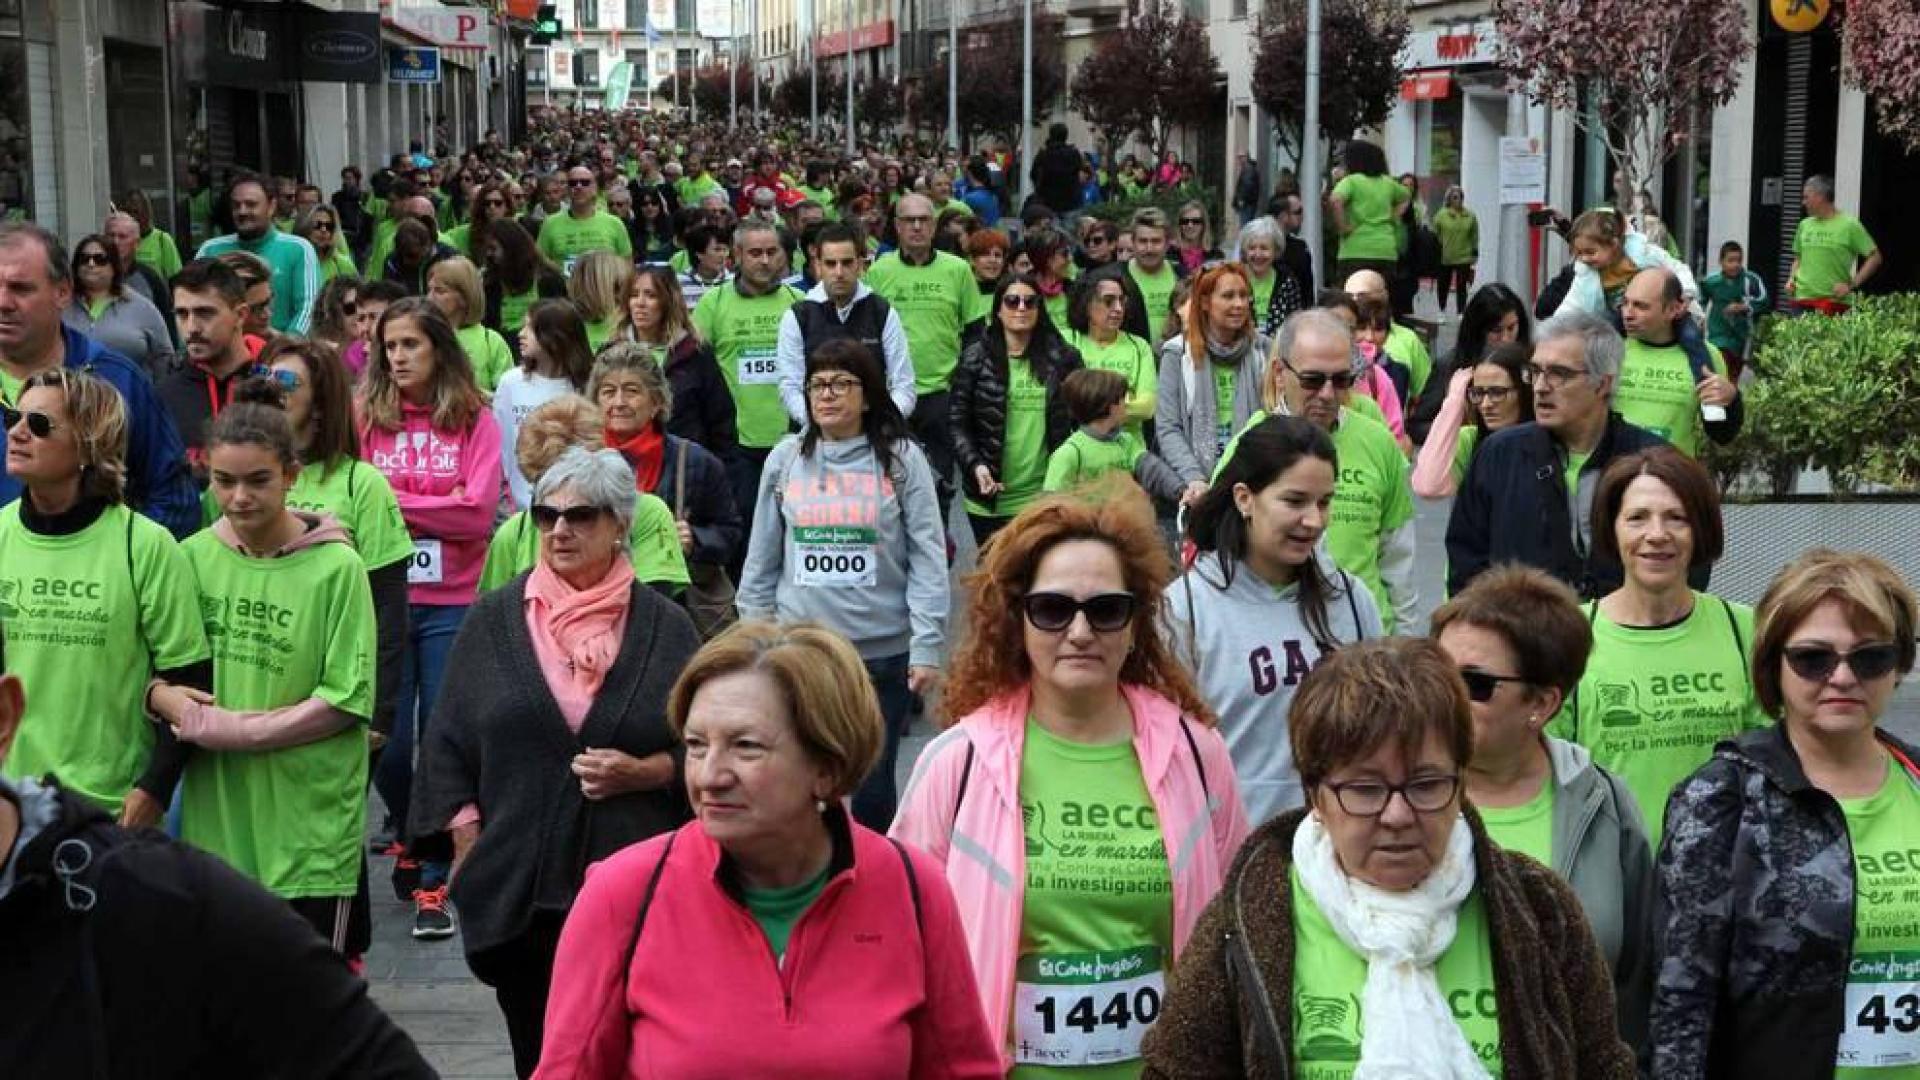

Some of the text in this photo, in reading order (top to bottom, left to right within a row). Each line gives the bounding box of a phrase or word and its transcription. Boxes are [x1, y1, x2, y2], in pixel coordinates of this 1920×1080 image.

[456, 15, 476, 41] P
[744, 360, 776, 374] 155
[804, 555, 865, 573] 0000
[32, 577, 101, 600] aecc
[236, 598, 294, 629] aecc
[1248, 639, 1336, 696] GA
[1650, 672, 1727, 696] aecc
[1061, 801, 1156, 830] aecc
[1028, 872, 1173, 897] la investigación
[1057, 960, 1093, 977] Corte
[1035, 986, 1161, 1035] 1440
[1856, 994, 1920, 1035] 43
